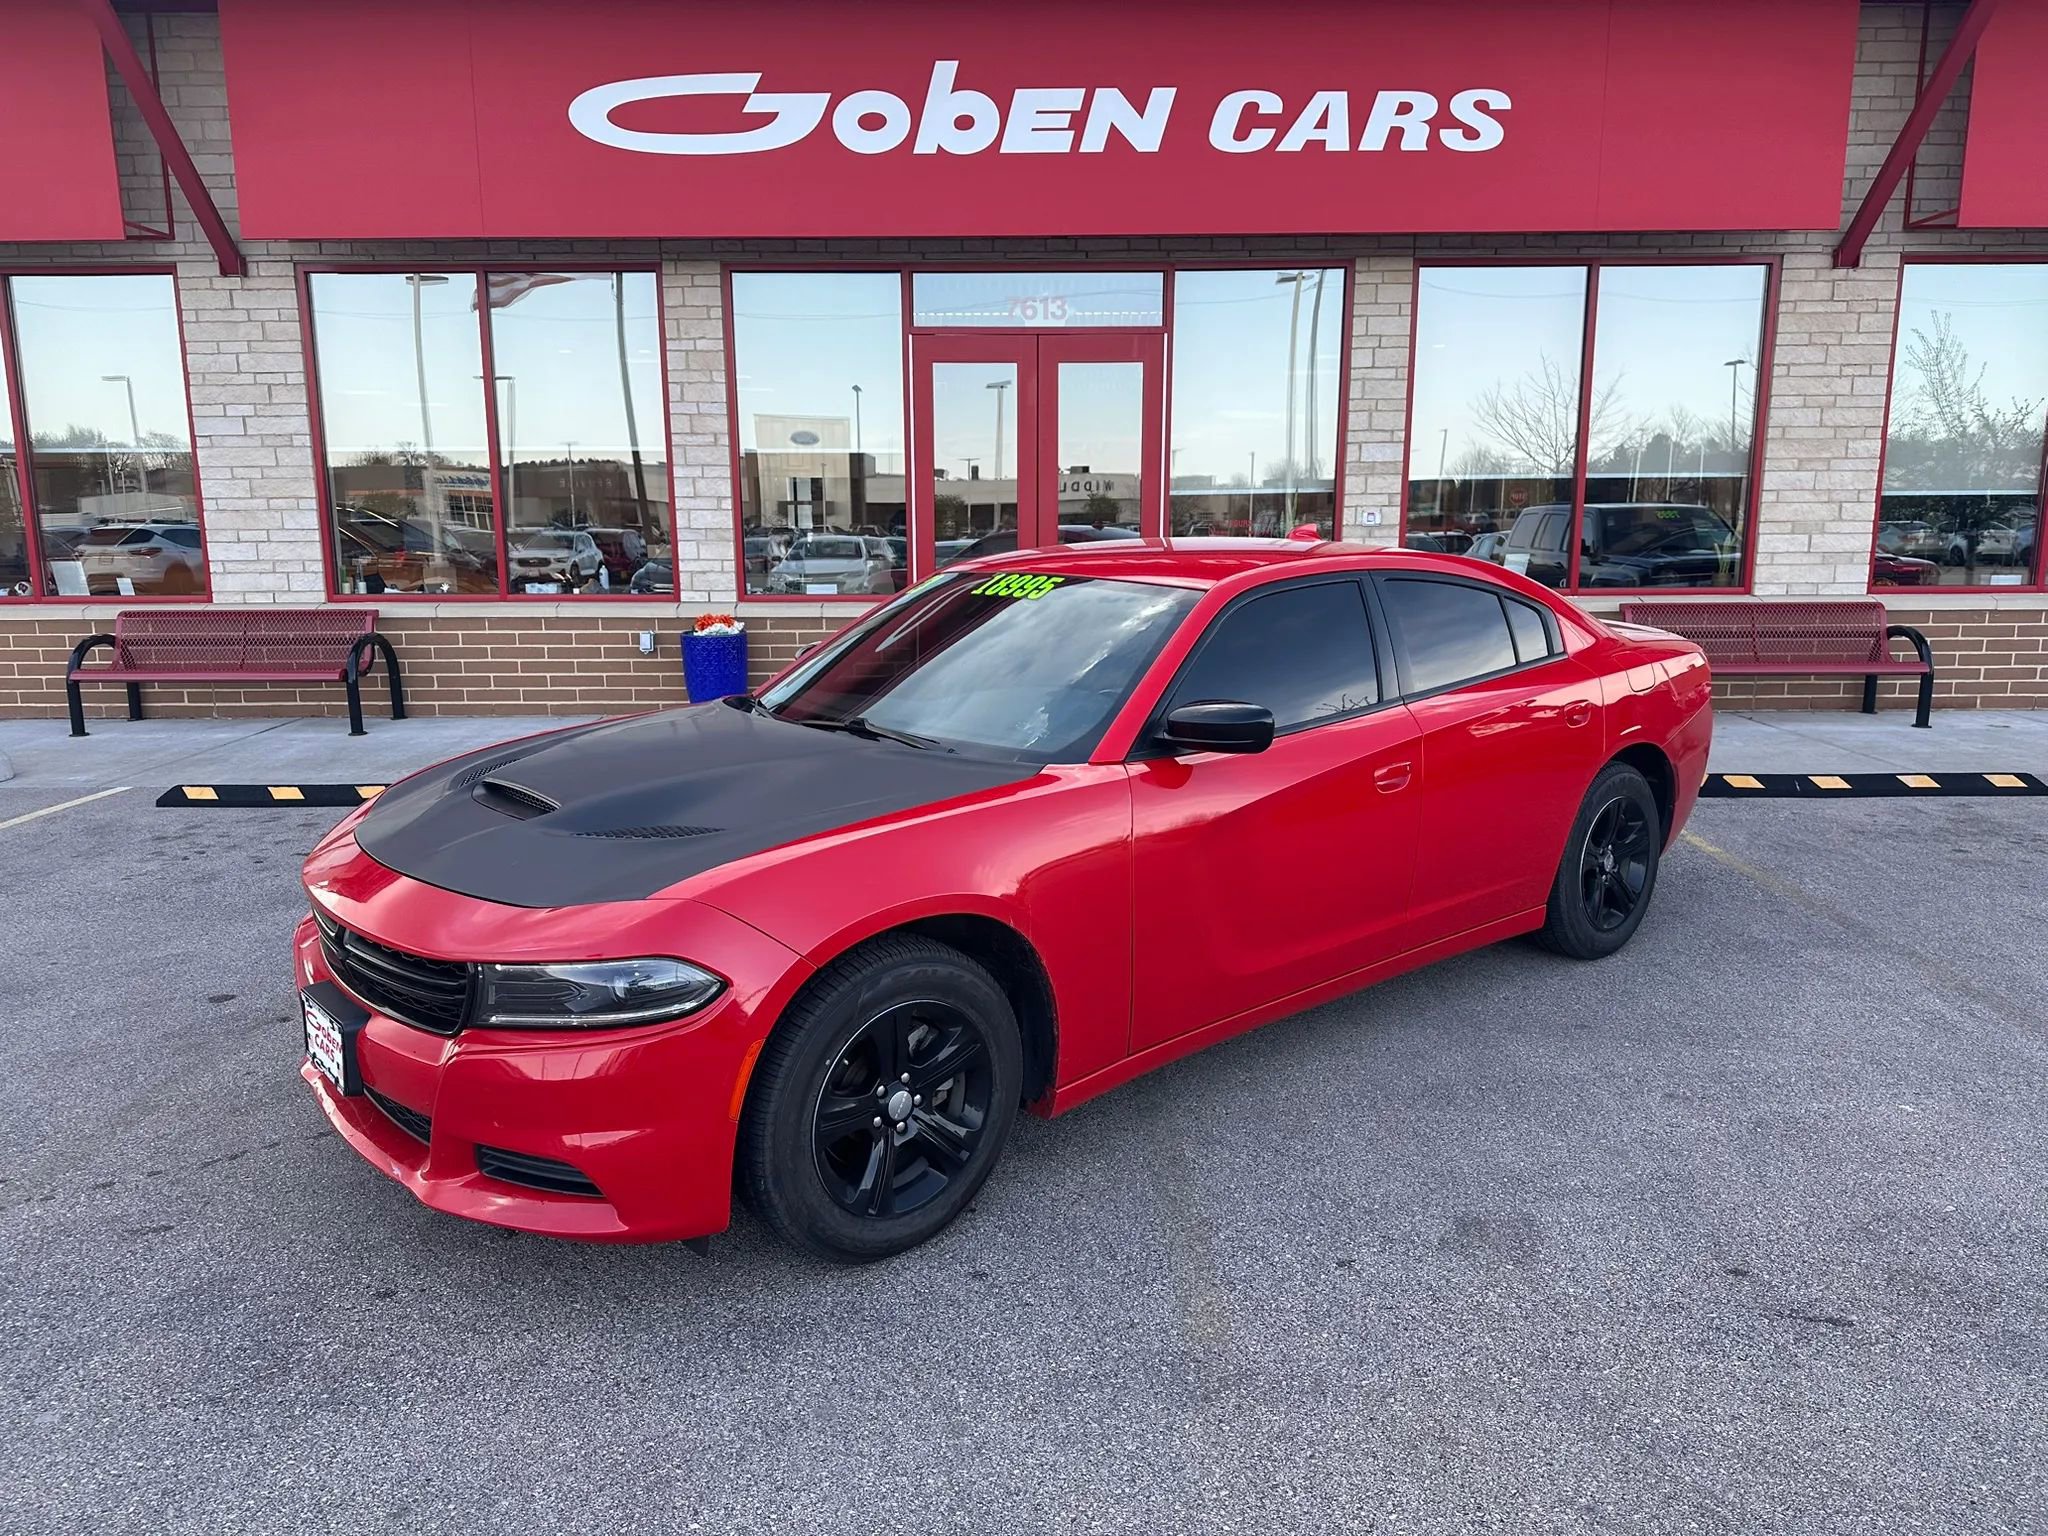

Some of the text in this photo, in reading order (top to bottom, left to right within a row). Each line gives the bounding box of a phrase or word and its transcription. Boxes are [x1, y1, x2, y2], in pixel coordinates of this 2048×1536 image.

[1209, 88, 1512, 154] CARS
[1007, 296, 1068, 320] 7613
[971, 573, 1065, 600] 18995
[314, 1033, 336, 1062] CARS
